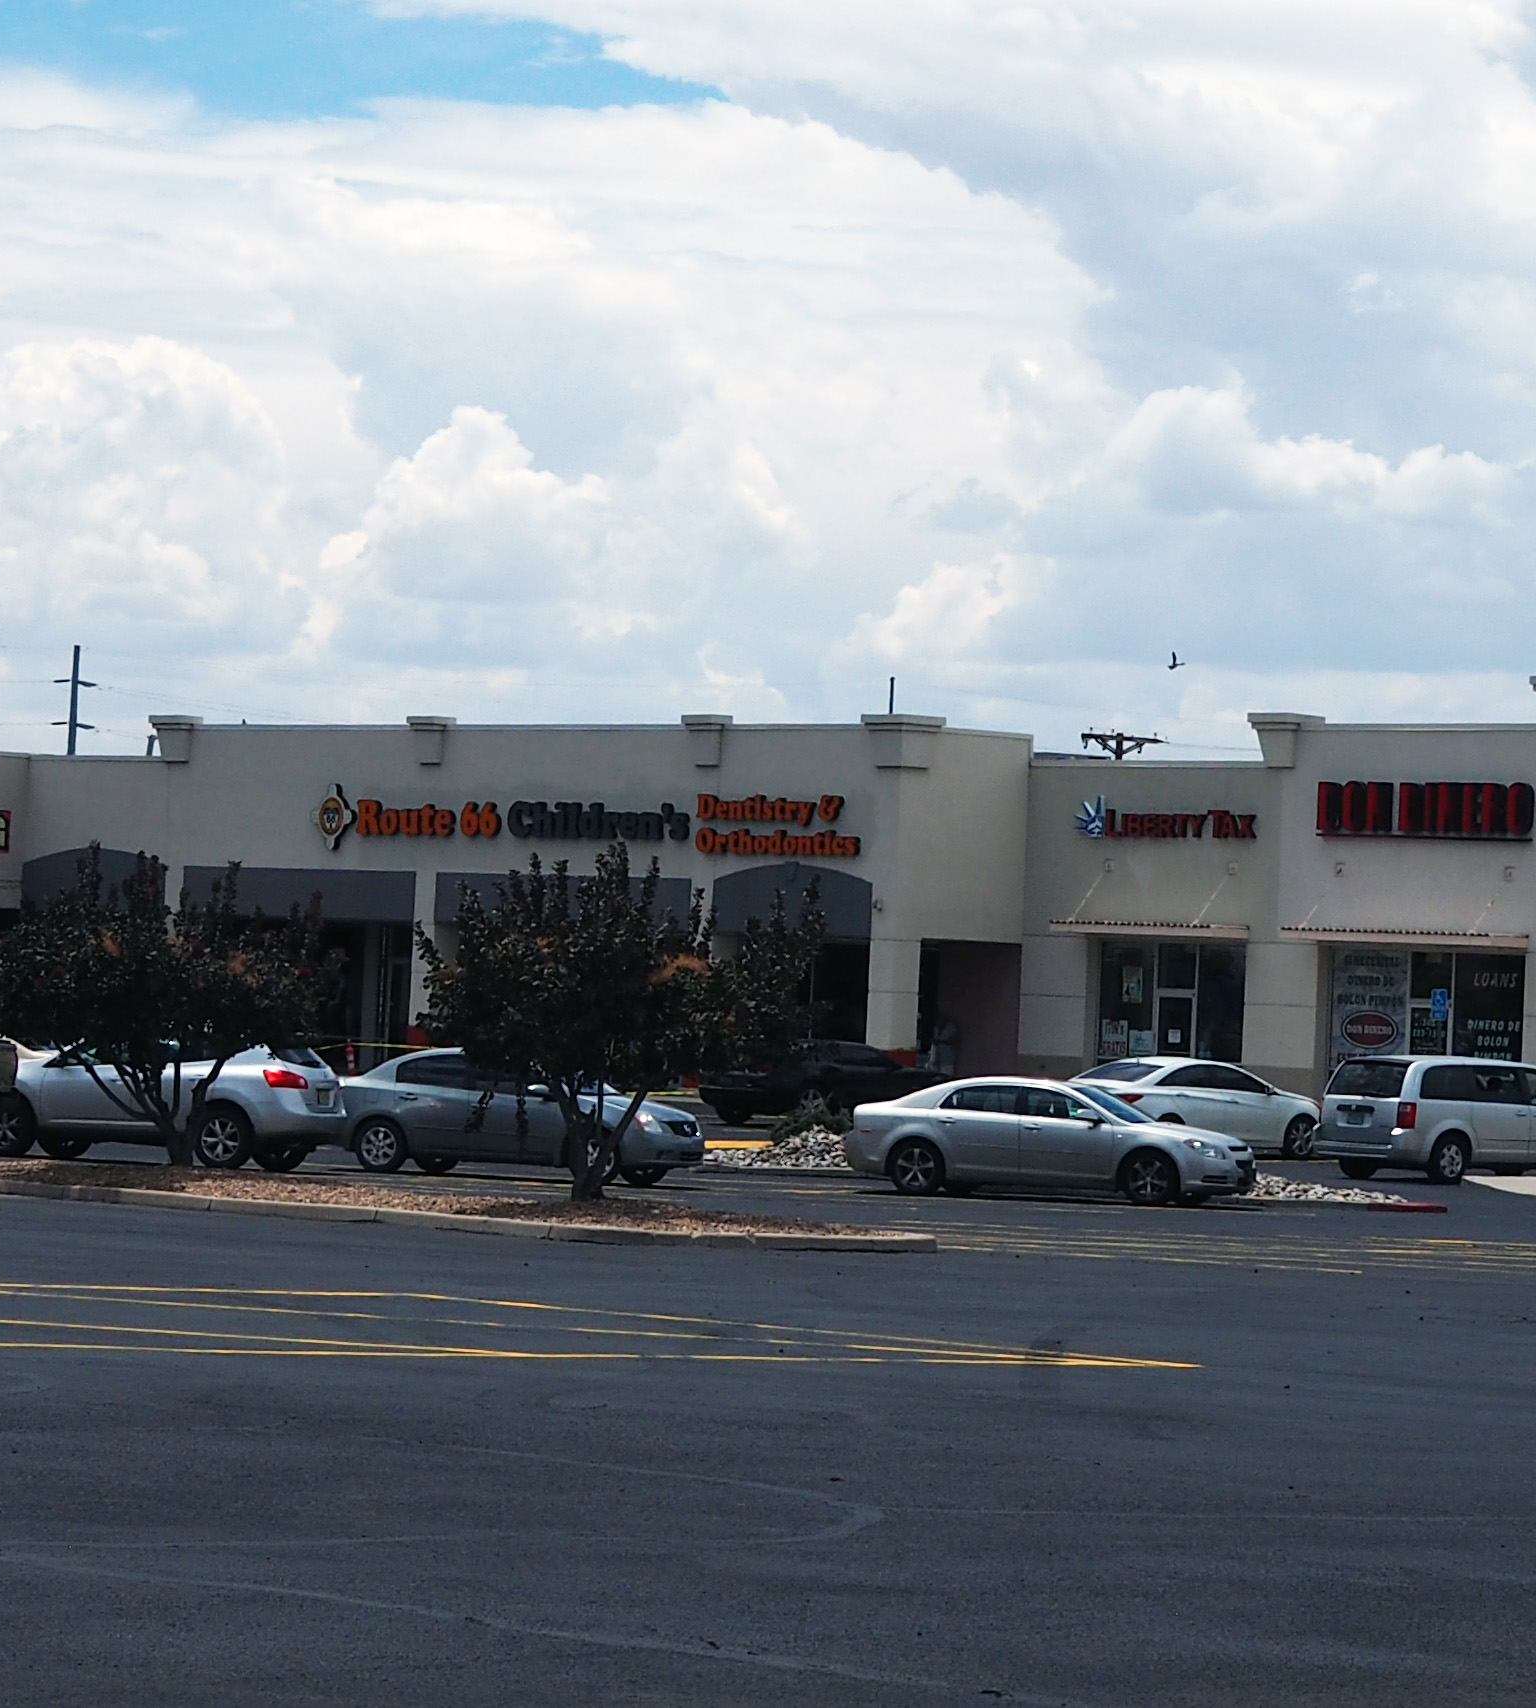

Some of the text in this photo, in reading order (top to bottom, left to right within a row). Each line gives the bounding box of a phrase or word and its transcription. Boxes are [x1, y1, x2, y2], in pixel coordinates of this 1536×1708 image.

[696, 793, 845, 827] Dentistry &
[1316, 781, 1535, 835] DON DINERO
[356, 799, 691, 842] Route 66 Children's
[695, 826, 861, 857] Orthodontics
[1473, 972, 1518, 988] LOANS
[1346, 1023, 1363, 1035] DON
[1467, 1018, 1521, 1033] DINERO DE
[1477, 1034, 1510, 1048] BOLON
